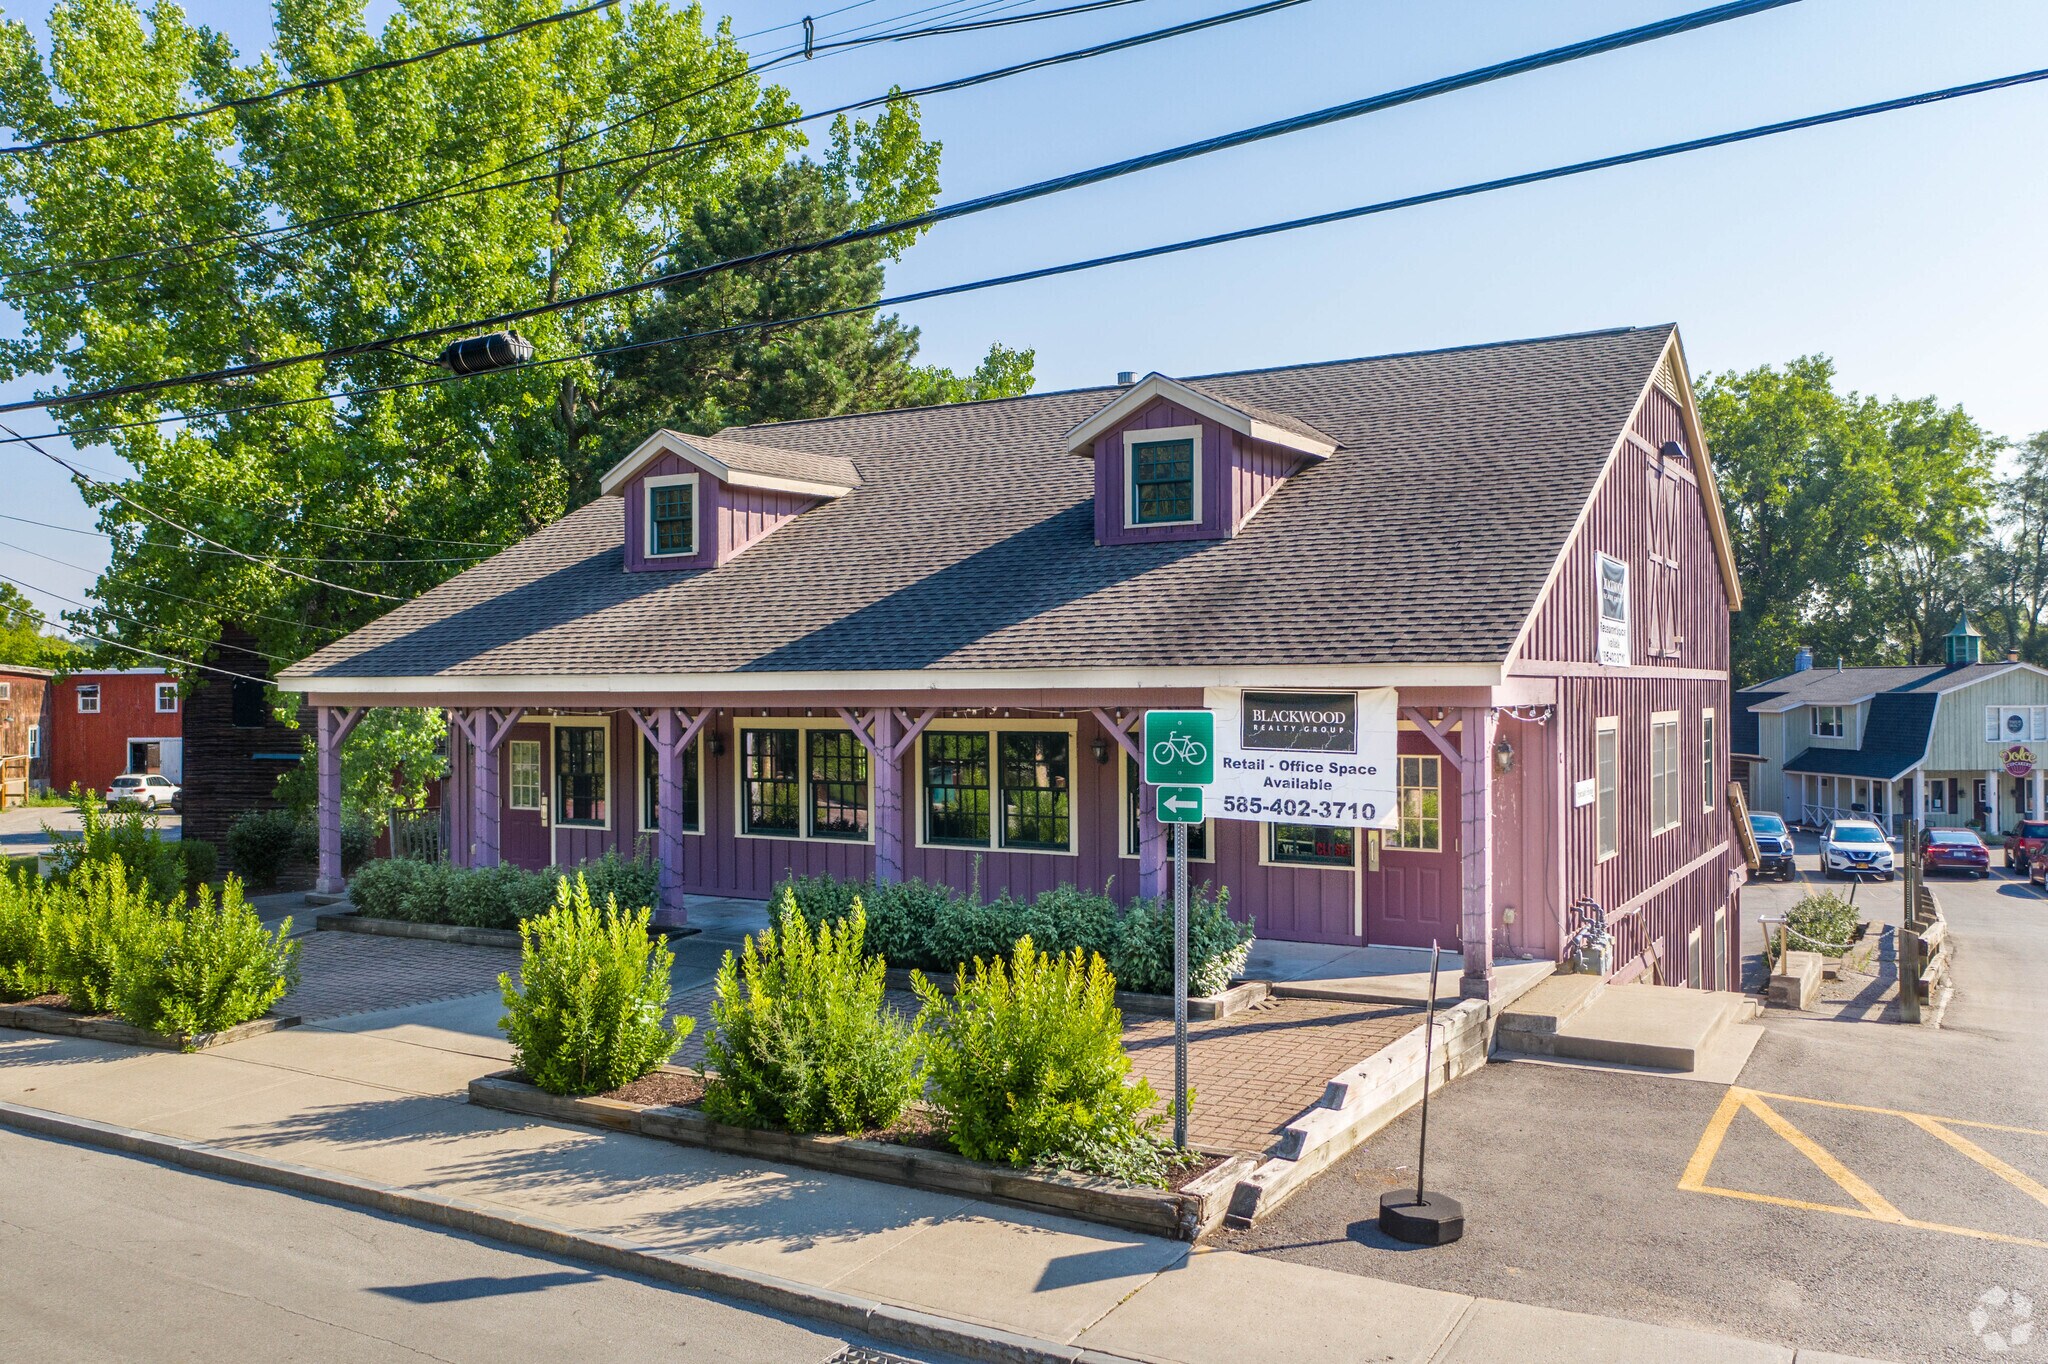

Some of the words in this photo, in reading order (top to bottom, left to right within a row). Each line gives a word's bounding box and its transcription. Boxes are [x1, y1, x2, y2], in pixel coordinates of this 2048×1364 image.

[1252, 709, 1346, 724] BLACKWOOD
[1253, 724, 1296, 732] REALTY
[1303, 726, 1344, 734] GROUP
[1999, 746, 2038, 764] Dolce
[1223, 757, 1265, 771] Retail
[1279, 760, 1324, 773] Office
[1329, 762, 1377, 777] Space
[1263, 776, 1333, 791] Available
[1223, 795, 1376, 821] 585-402-3710
